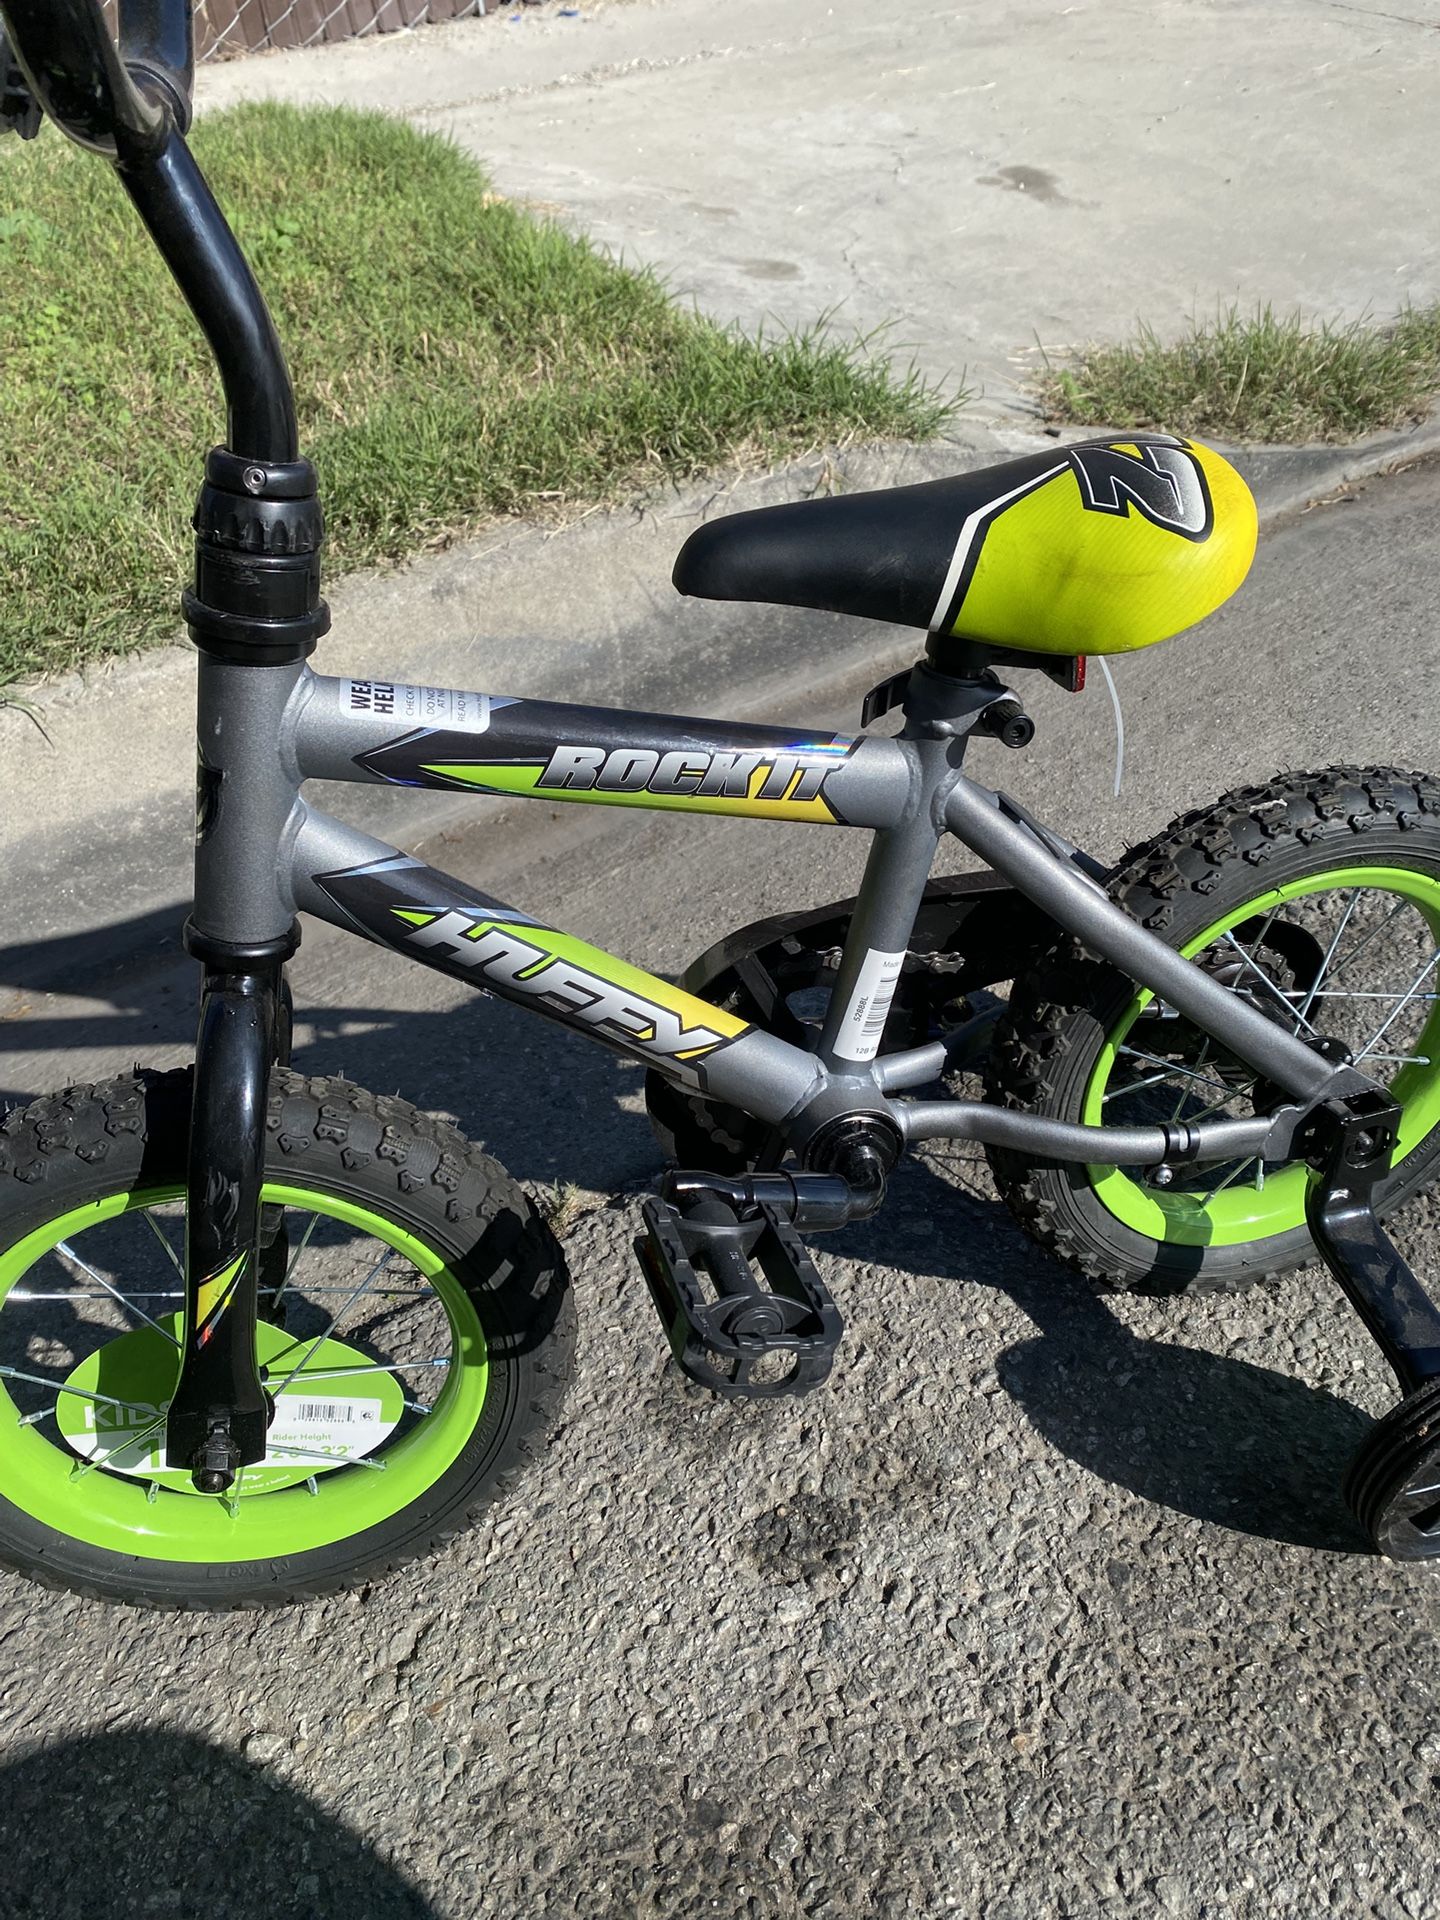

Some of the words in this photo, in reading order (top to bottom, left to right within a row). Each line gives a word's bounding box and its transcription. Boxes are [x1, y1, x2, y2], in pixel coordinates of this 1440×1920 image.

[405, 690, 414, 716] CHECK
[426, 702, 435, 715] DO
[438, 698, 446, 709] AT
[457, 700, 466, 722] READ
[539, 745, 763, 797] ROCK
[759, 753, 845, 800] IT
[403, 910, 724, 1054] HUFFY
[853, 996, 869, 1022] 52888L
[132, 1430, 164, 1438] Weel
[272, 1433, 297, 1441] Rider
[300, 1433, 332, 1442] Height
